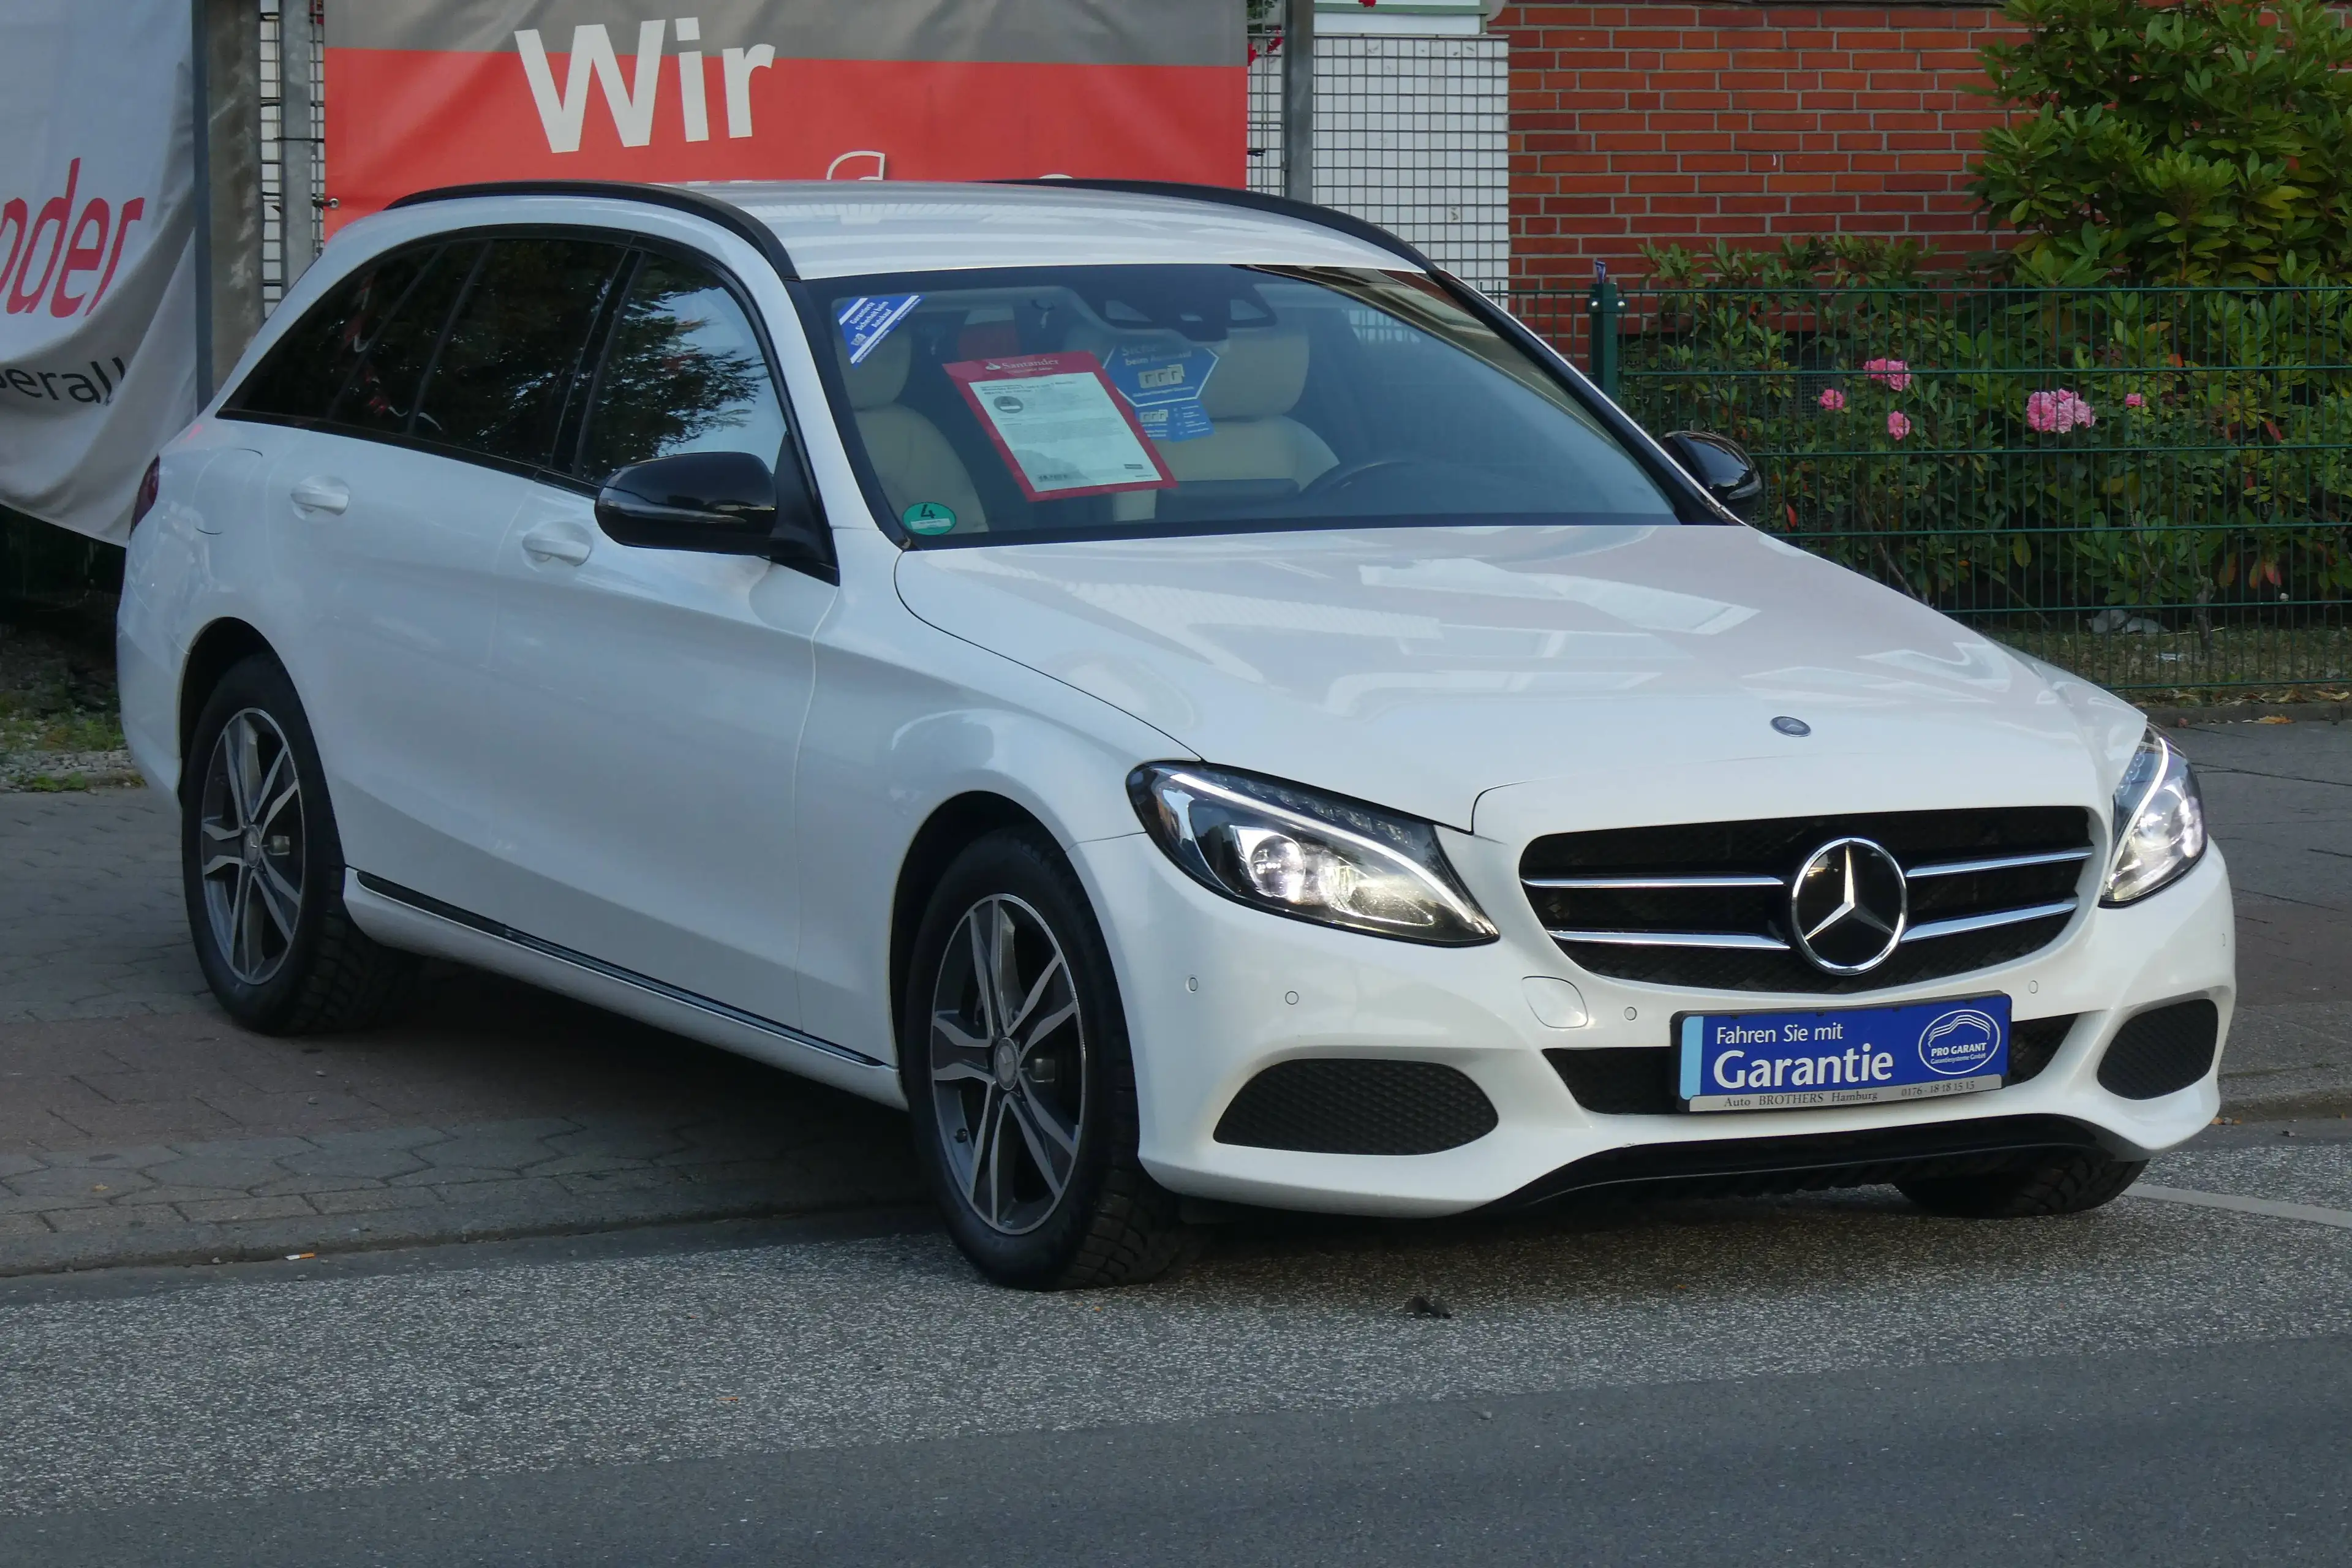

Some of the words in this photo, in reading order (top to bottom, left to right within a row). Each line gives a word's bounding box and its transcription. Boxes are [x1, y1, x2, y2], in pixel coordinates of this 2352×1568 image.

[514, 17, 775, 153] Wir
[1001, 358, 1059, 370] Santander
[920, 504, 936, 519] 4
[1716, 1025, 1776, 1044] Fahren
[1783, 1024, 1809, 1042] Sie
[1814, 1022, 1844, 1041] mit
[1931, 1047, 1950, 1057] PRO
[1951, 1042, 1987, 1055] GARANT
[1713, 1043, 1893, 1089] Garantie
[1724, 1097, 1751, 1107] Auto
[1758, 1093, 1824, 1106] BROTHERS
[1831, 1091, 1878, 1102] Hamburg
[1901, 1086, 1923, 1097] 0176
[1930, 1084, 1940, 1094] 18
[1942, 1082, 1952, 1092] 18
[1954, 1082, 1963, 1091] 15
[1966, 1080, 1975, 1090] 15
